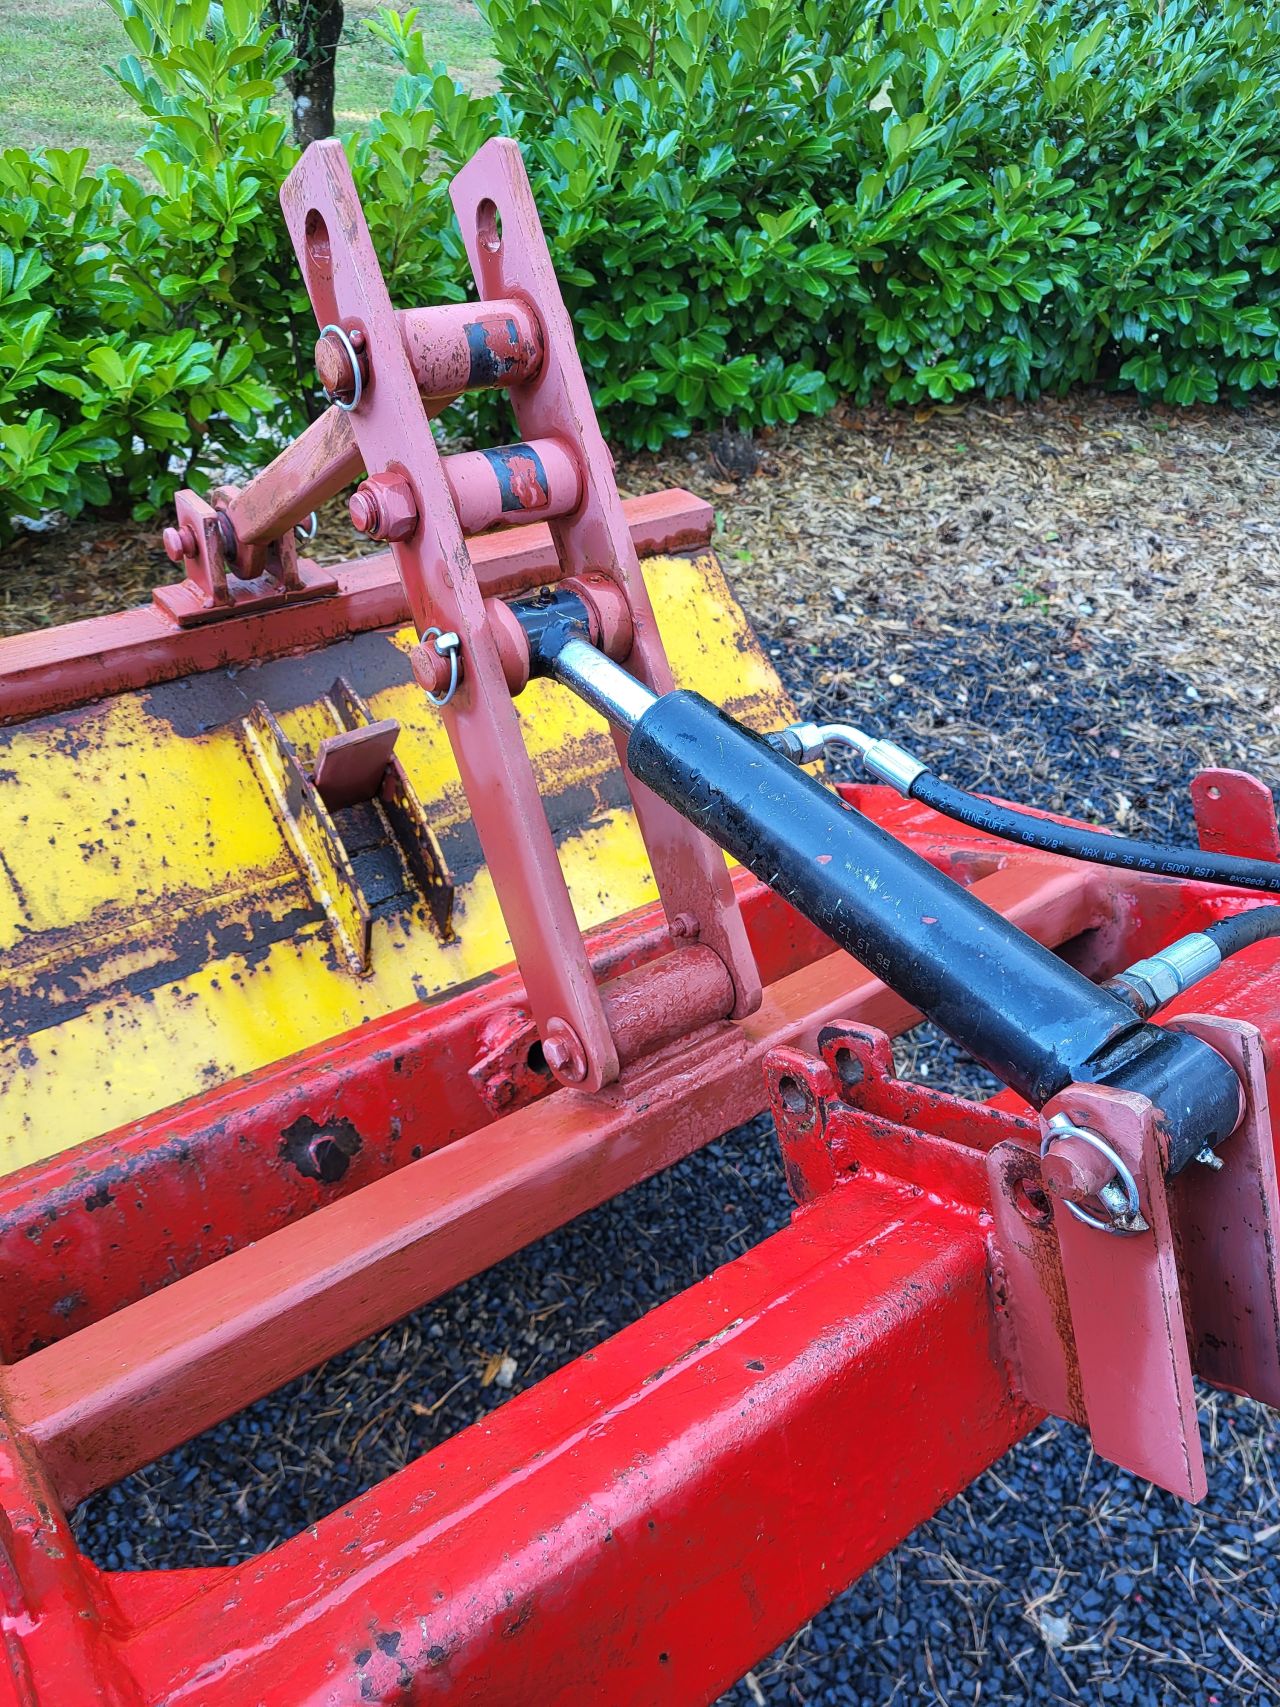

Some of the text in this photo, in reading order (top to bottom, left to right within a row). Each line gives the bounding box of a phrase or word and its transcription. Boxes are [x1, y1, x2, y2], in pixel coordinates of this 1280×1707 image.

[959, 808, 1006, 832] MINETUFF
[1040, 836, 1064, 849] 3/8"
[1080, 845, 1100, 858] MAX
[1103, 851, 1117, 861] WP
[1121, 854, 1135, 865] 35
[1138, 857, 1156, 869] MPa
[1161, 862, 1190, 874] (5000
[1193, 866, 1216, 878] PSI)
[1229, 875, 1266, 886] exceeds
